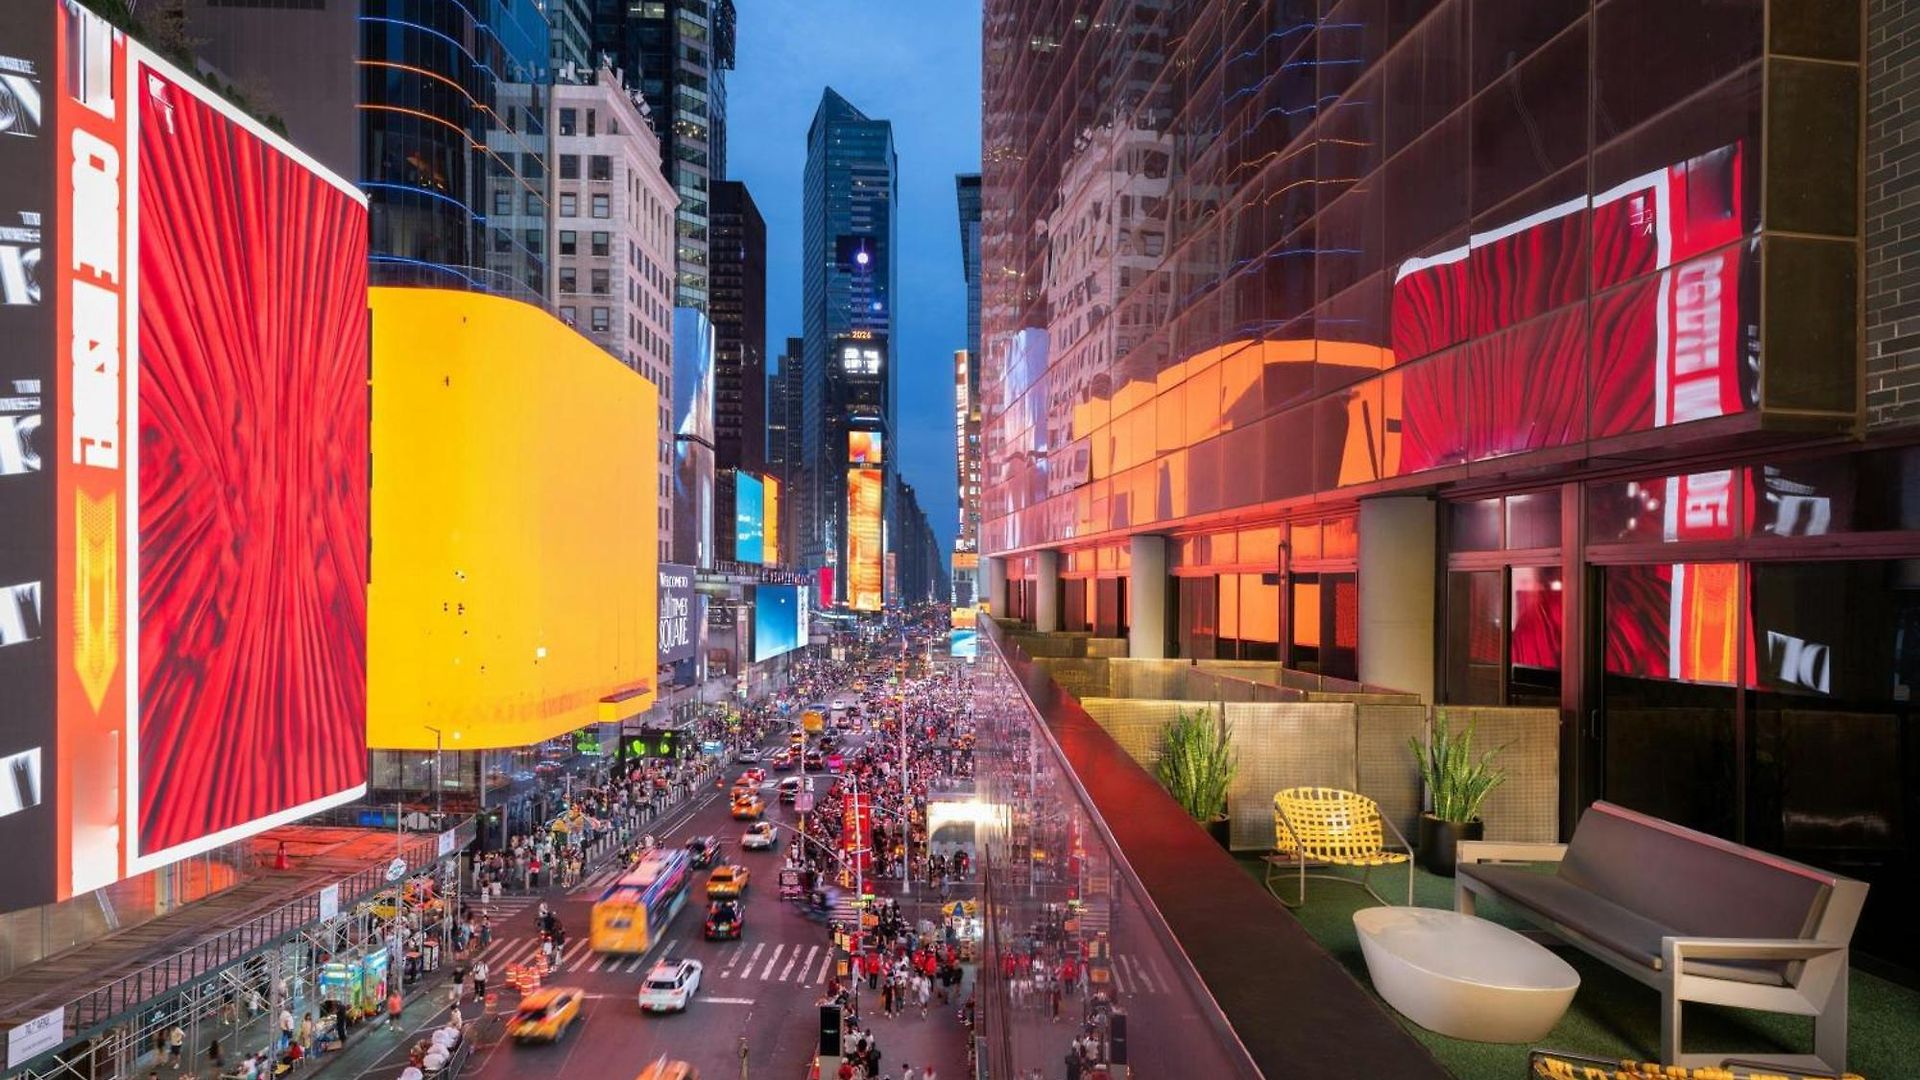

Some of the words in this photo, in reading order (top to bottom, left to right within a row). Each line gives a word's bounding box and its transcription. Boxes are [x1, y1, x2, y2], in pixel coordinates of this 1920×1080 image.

[72, 129, 119, 286] COE
[72, 279, 119, 469] ISDE!
[852, 330, 872, 339] 2026
